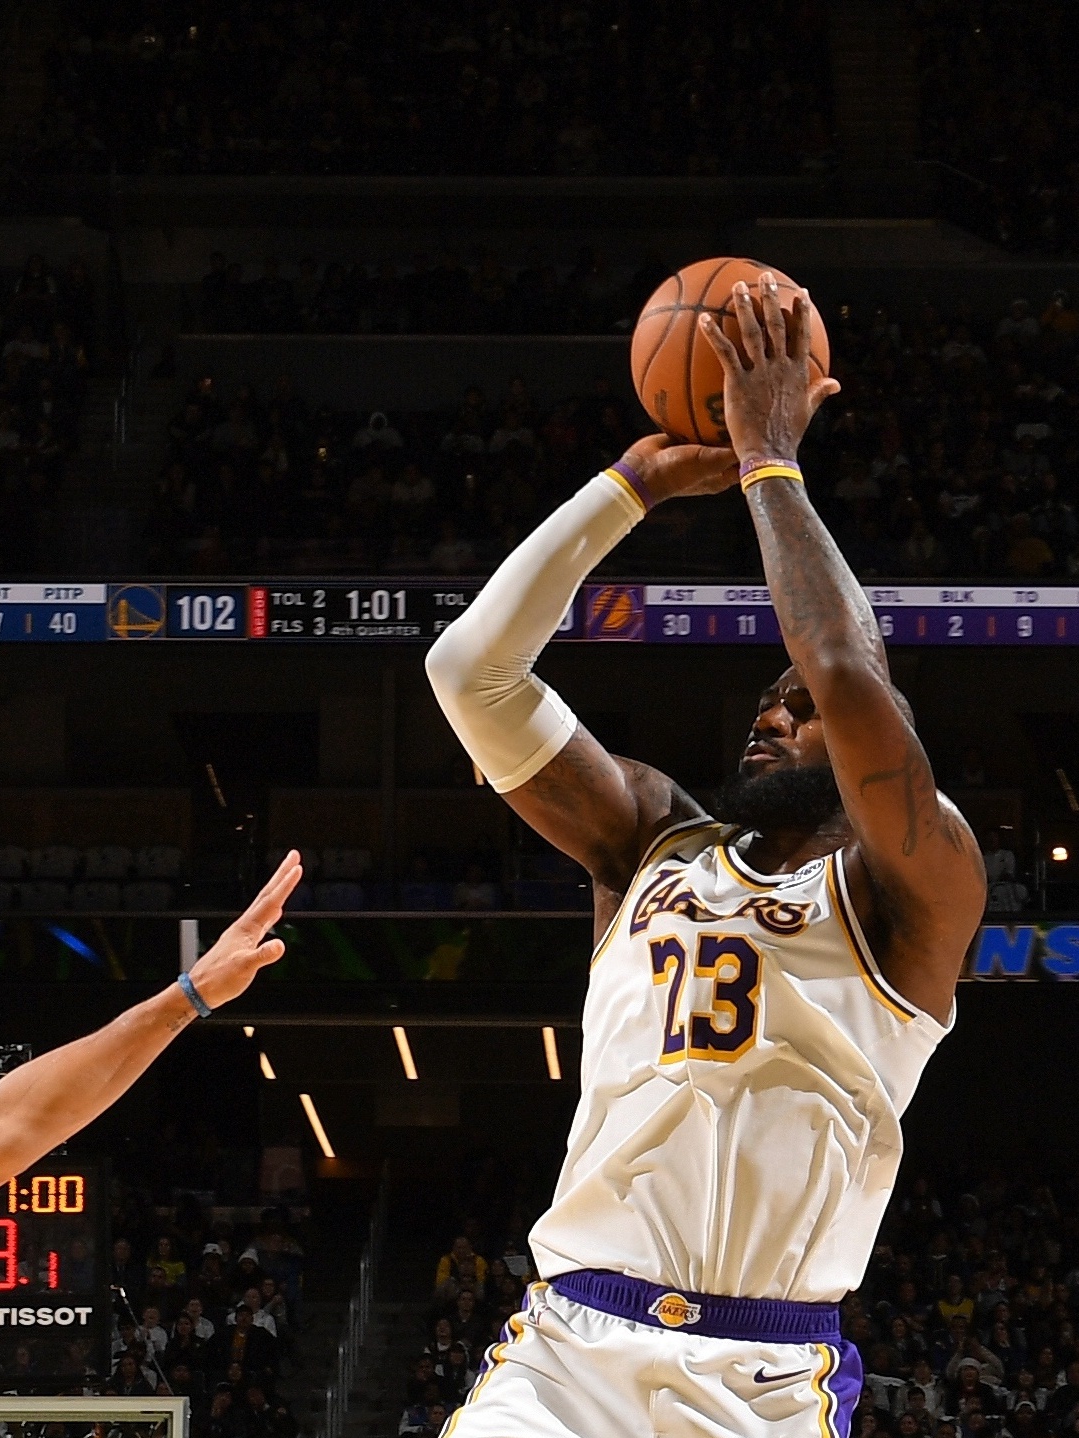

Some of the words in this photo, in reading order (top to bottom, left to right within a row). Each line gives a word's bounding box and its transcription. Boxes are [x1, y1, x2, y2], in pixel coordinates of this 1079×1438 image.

[43, 587, 84, 600] PITP
[271, 592, 307, 606] TOL
[312, 589, 327, 608] 2
[432, 593, 469, 606] TOL
[662, 589, 697, 601] AST
[938, 590, 974, 603] BLK
[1013, 590, 1040, 603] TO
[176, 595, 237, 631] 102
[345, 589, 407, 621] 1:01
[48, 612, 78, 634] 40
[271, 619, 305, 633] FLS
[312, 616, 327, 636] 3
[355, 626, 421, 636] QUARTER
[662, 613, 692, 636] 30
[736, 613, 756, 636] 11
[947, 615, 965, 637] 2
[1016, 615, 1034, 637] 9
[647, 931, 765, 1065] 23
[8, 1175, 85, 1214] 1:00
